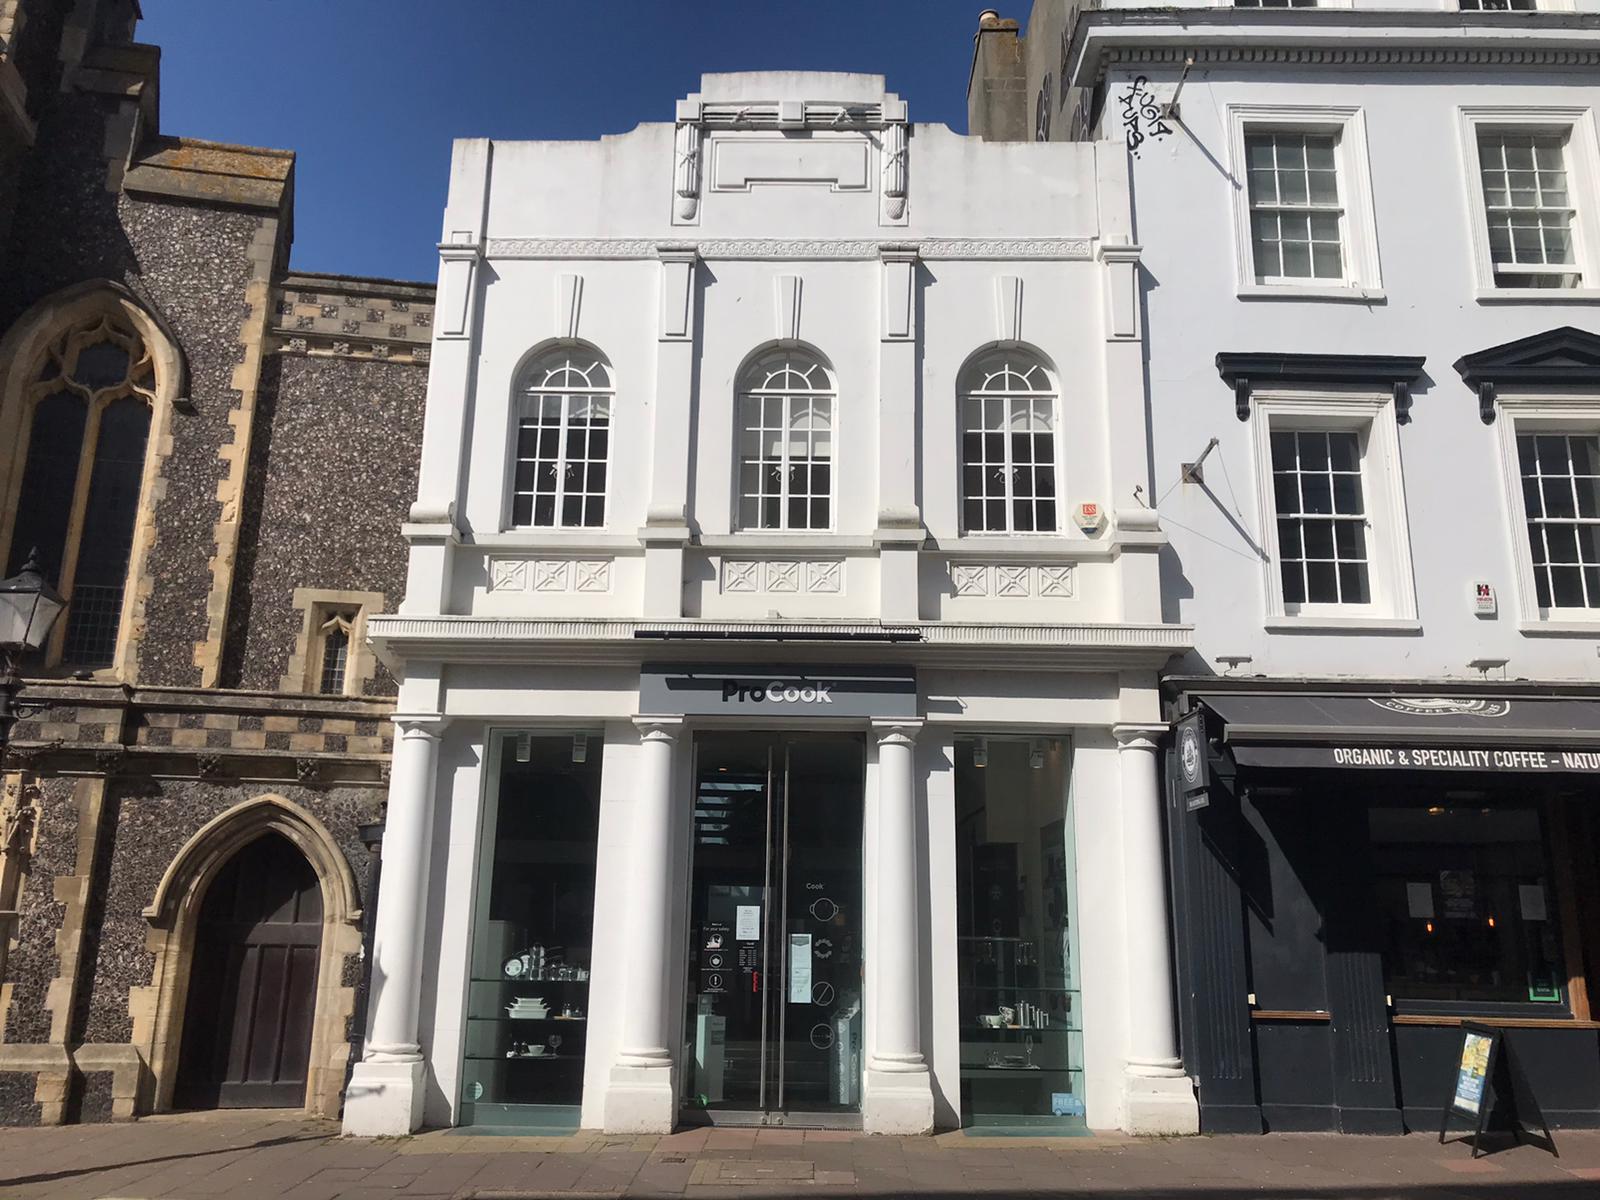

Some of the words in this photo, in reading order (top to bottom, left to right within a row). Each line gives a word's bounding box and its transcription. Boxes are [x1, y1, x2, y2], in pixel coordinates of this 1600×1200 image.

[722, 680, 833, 702] ProCook
[1333, 748, 1395, 765] ORGANIC
[1398, 750, 1409, 765] &
[1412, 749, 1489, 767] SPECIALITY
[1493, 751, 1548, 768] COFFEE
